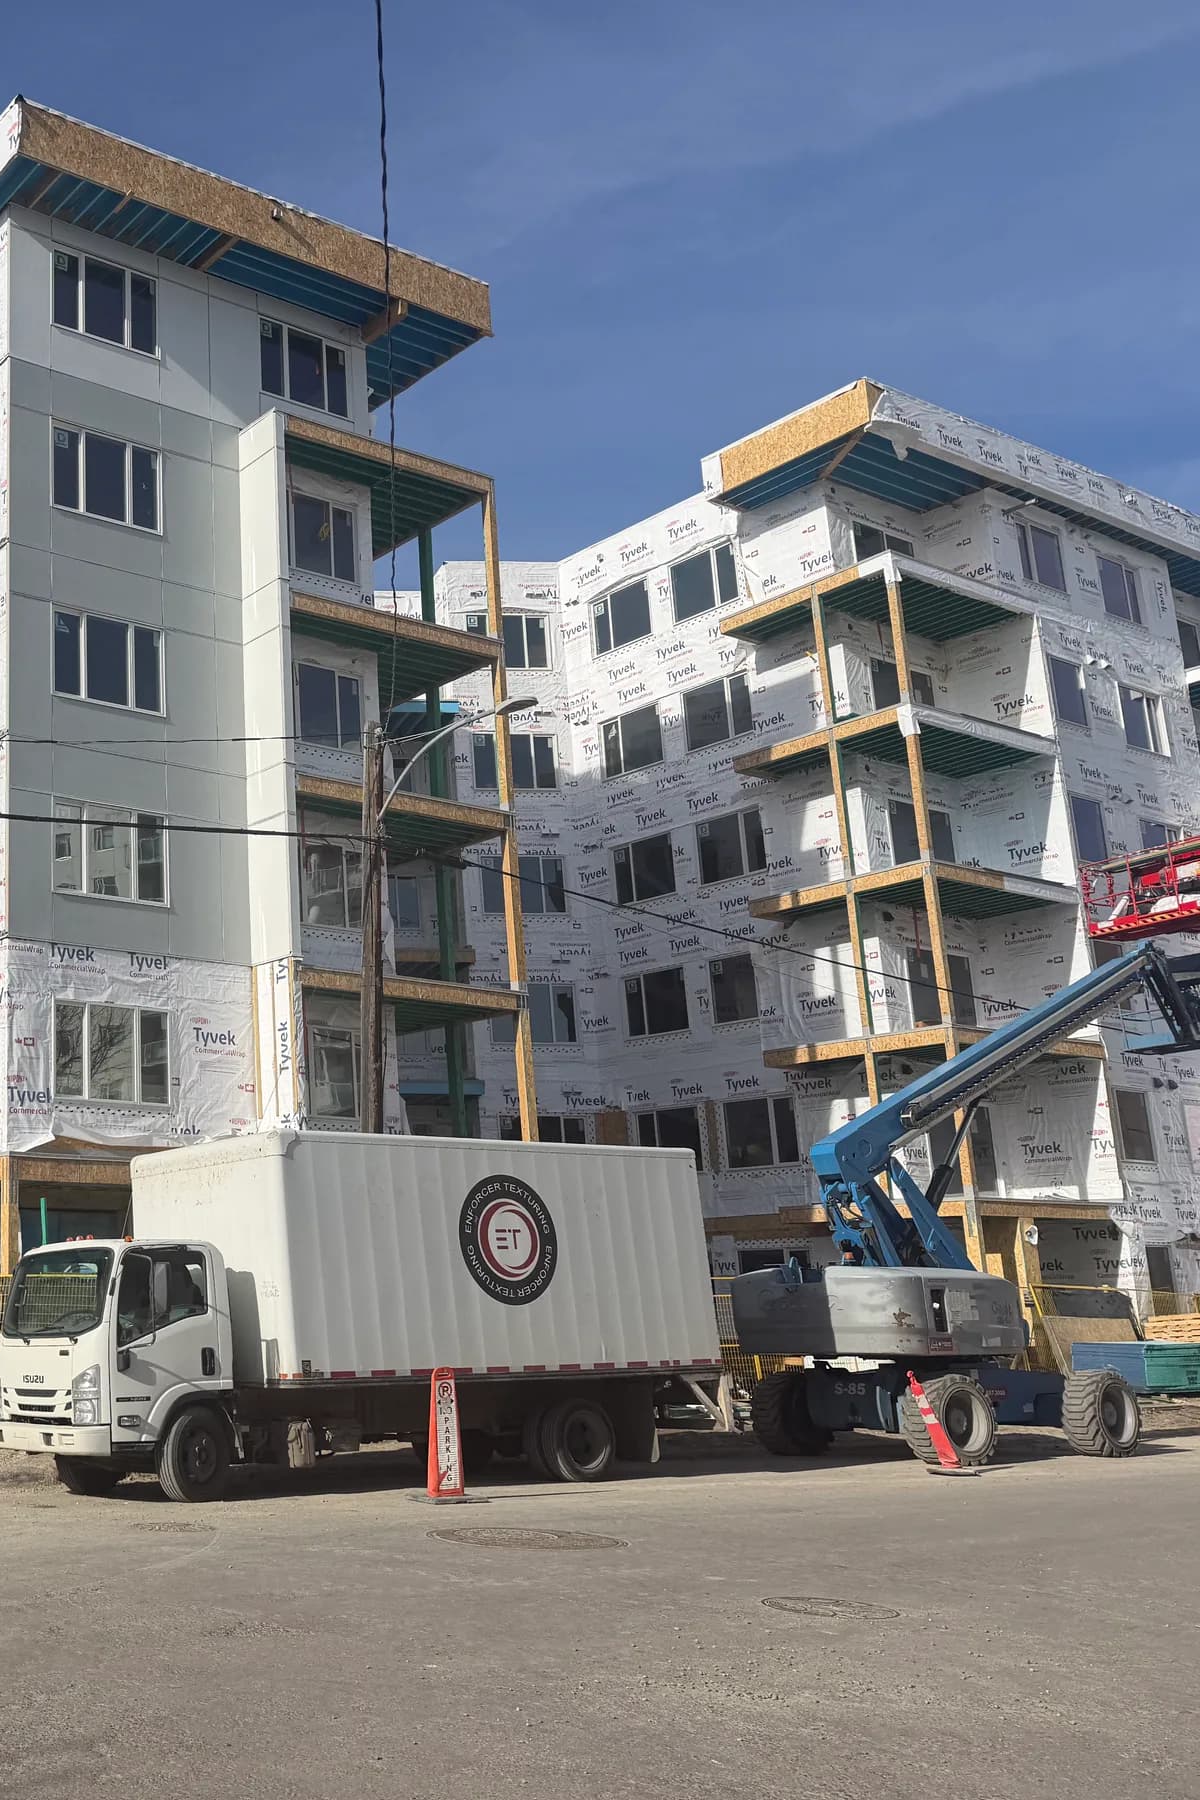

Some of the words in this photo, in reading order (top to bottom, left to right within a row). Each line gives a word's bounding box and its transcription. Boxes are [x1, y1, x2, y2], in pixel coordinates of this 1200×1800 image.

[937, 429, 963, 449] Tyvek
[978, 446, 1004, 465] Tyvek
[1054, 463, 1077, 480] Tyvek
[667, 519, 697, 541] Tyvek
[620, 541, 648, 565] Tyvek
[1076, 574, 1099, 589] Tyvek
[560, 621, 588, 644] Tyvek
[1058, 632, 1081, 648] Tyvek
[655, 640, 686, 659] Tyvek
[607, 661, 636, 681] Tyvek
[666, 663, 697, 683] Tyvek
[1124, 659, 1144, 673] Tyvek
[617, 682, 646, 701] Tyvek
[994, 694, 1034, 714] Tyvek
[1090, 702, 1112, 717] Tyvek
[752, 712, 786, 732] Tyvek
[1079, 764, 1101, 778] Tyvek
[687, 792, 719, 810] Tyvek
[1137, 790, 1158, 804] Tyvek
[635, 809, 666, 825] Tyvek
[1008, 842, 1048, 861] Tyvek
[578, 867, 608, 883] Tyvek
[613, 923, 644, 940] Tyvek
[668, 935, 700, 952] Tyvek
[50, 943, 95, 966] Tyvek
[619, 946, 648, 962] Tyvek
[870, 986, 896, 1002] yvek
[801, 995, 836, 1014] Tyvek
[982, 999, 1017, 1016] Tyvek
[193, 1027, 237, 1047] Tyvek
[278, 1021, 289, 1075] Tyvek
[1120, 1053, 1144, 1067] Tyvek
[1174, 1066, 1195, 1078] Tyvek
[671, 1084, 703, 1099] Tyvek
[725, 1075, 759, 1091] Tyvek
[792, 1077, 832, 1093] Tyvek
[1021, 1141, 1061, 1158] Tyvek
[465, 1182, 501, 1233] ENFORCER
[504, 1182, 550, 1234] TEXTURING
[1139, 1206, 1161, 1220] Tyvek
[467, 1245, 516, 1297] TEXTURING
[518, 1245, 552, 1297] ENFORCER
[23, 1375, 44, 1383] ISUZU
[834, 1383, 865, 1395] S-85
[444, 1416, 452, 1481] PARKING
